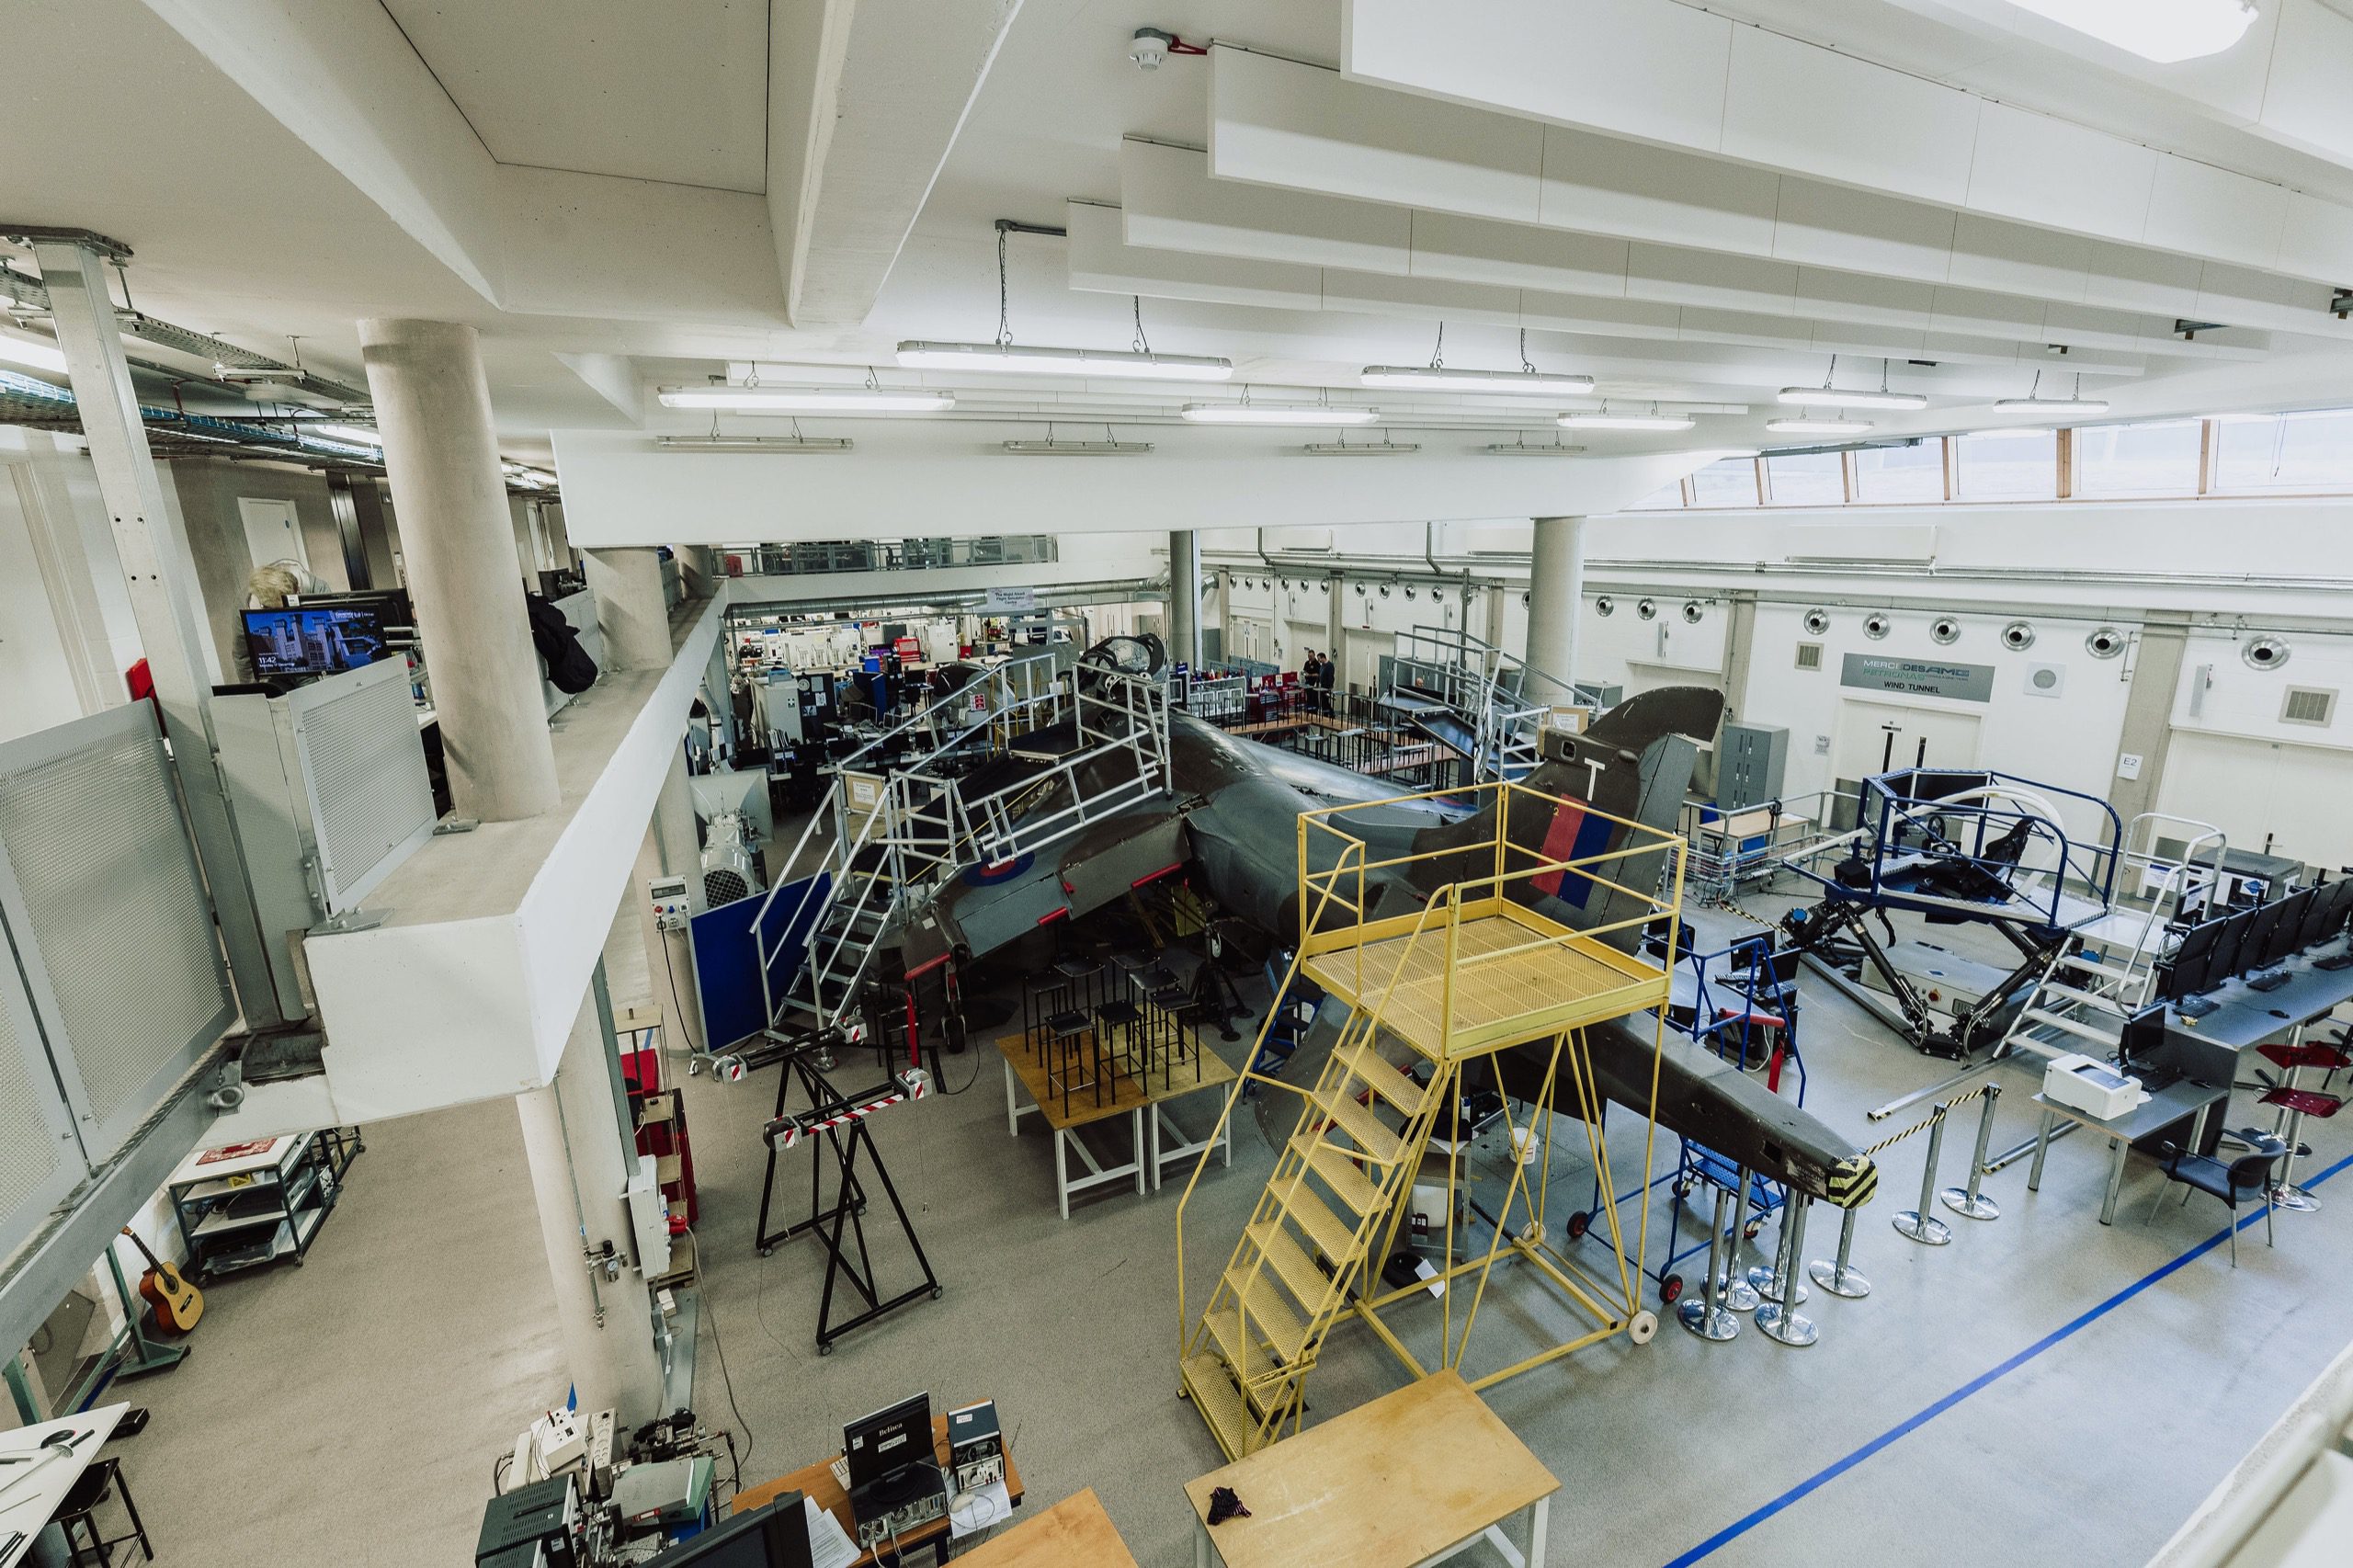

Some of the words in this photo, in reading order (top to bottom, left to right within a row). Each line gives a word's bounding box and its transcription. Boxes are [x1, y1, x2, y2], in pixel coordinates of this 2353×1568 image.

[258, 656, 277, 665] 11:42
[1863, 667, 1927, 681] PETRONAS
[1883, 680, 1905, 689] WIND
[1908, 683, 1941, 694] TUNNEL
[2123, 756, 2138, 767] E2
[1584, 757, 1606, 801] T
[1553, 807, 1560, 816] 2
